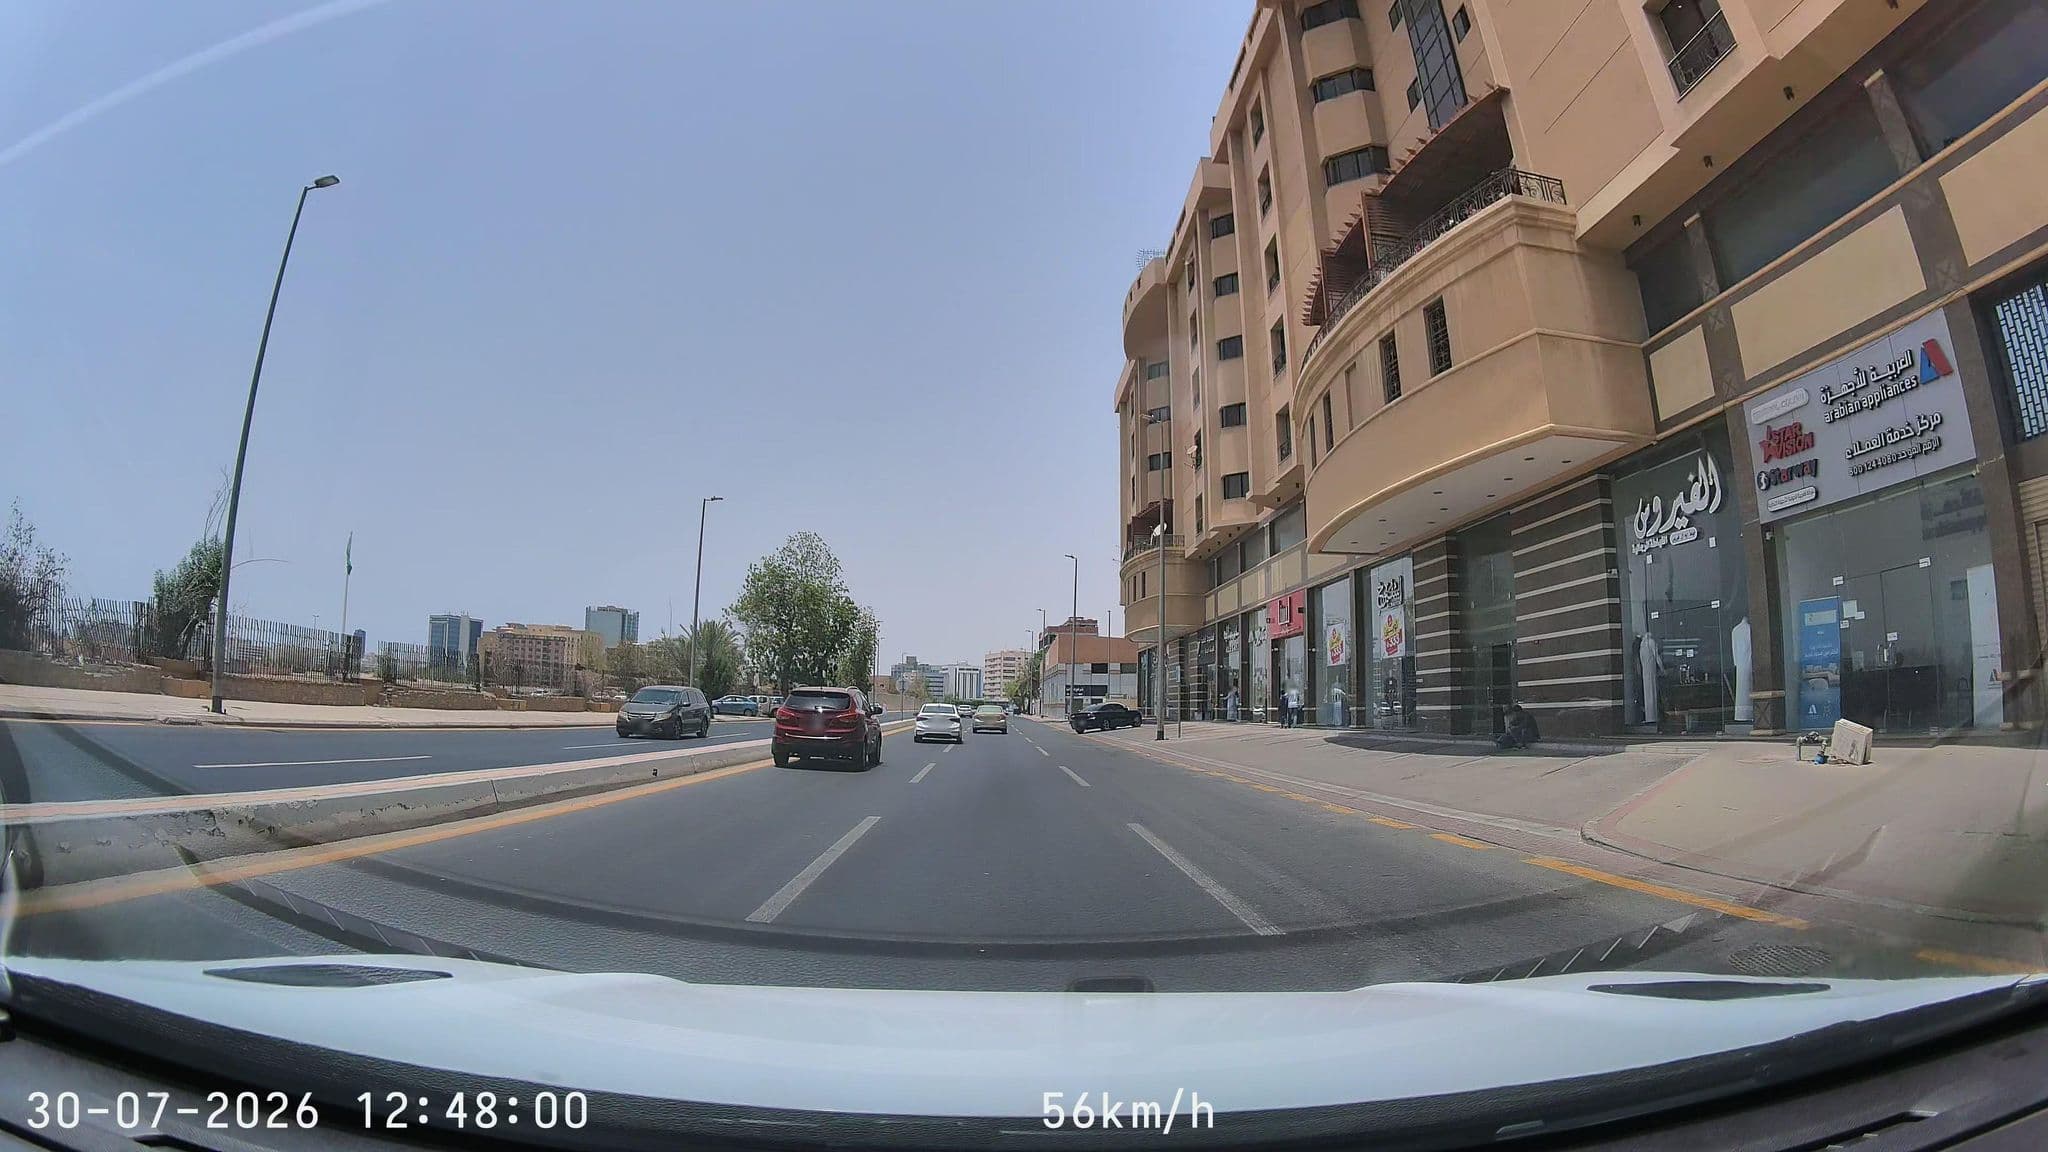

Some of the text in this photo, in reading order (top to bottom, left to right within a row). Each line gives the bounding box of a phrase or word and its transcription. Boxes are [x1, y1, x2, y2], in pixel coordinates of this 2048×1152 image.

[1870, 350, 1912, 382] العربية
[1824, 400, 1861, 423] arabian
[1862, 375, 1918, 410] appliances
[1770, 422, 1802, 443] STAR
[1845, 412, 1941, 459] مركز خدمة العملاء
